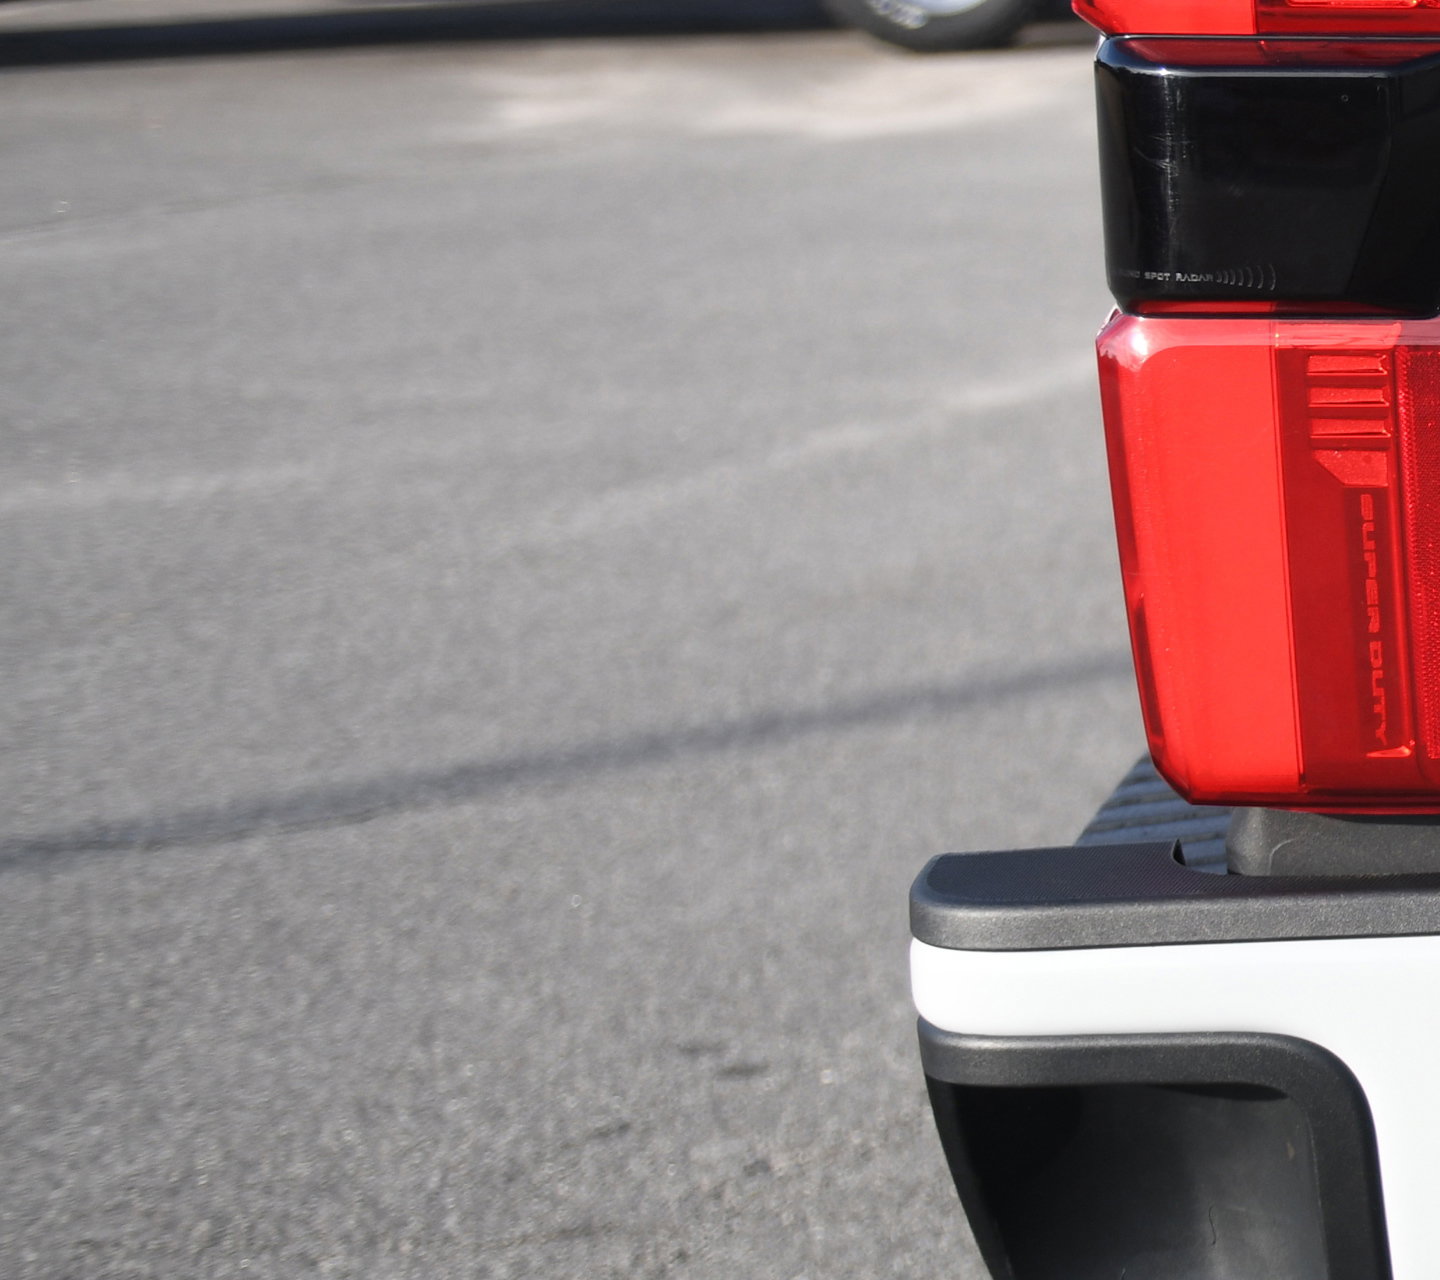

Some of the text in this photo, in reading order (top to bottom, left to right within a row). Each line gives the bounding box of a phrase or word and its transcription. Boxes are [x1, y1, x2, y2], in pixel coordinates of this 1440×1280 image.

[1144, 271, 1171, 281] SPOT
[1175, 273, 1214, 282] RADAR
[1360, 493, 1388, 746] SUPER DUTY
